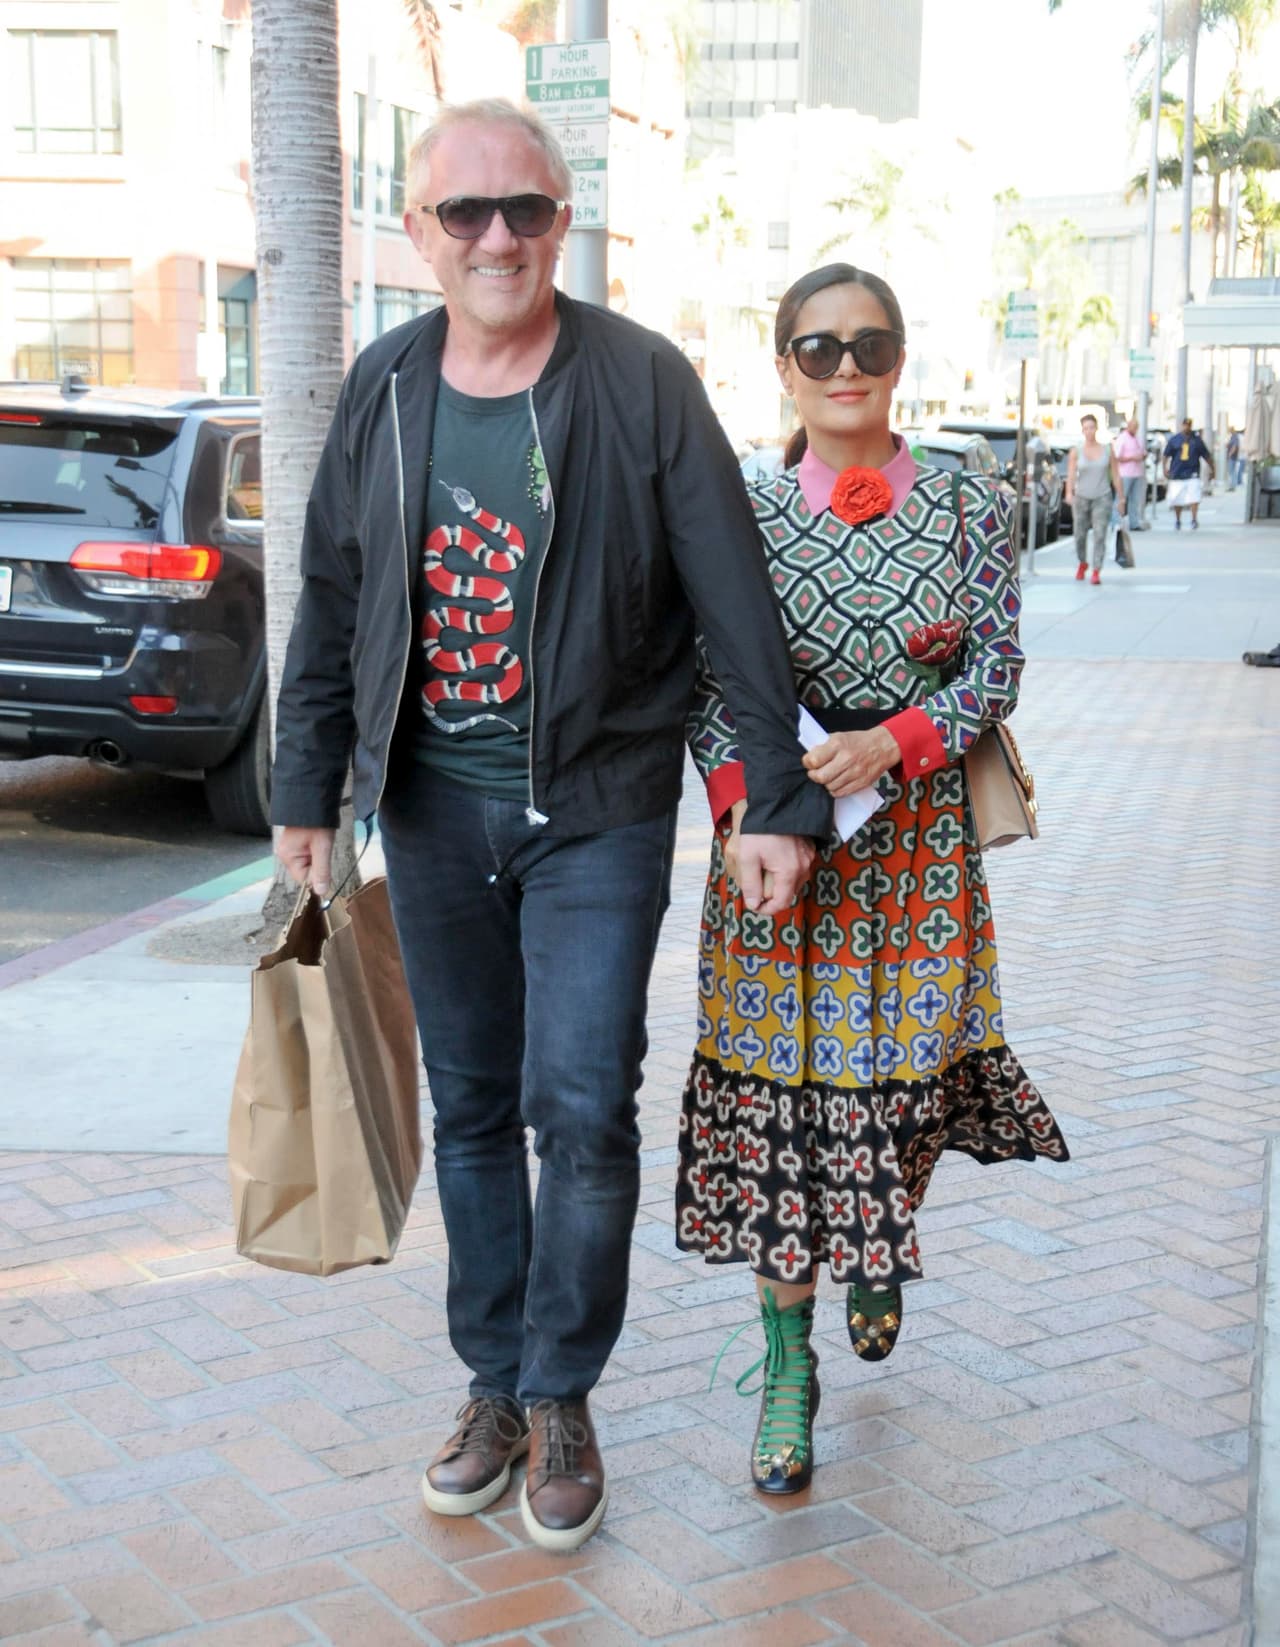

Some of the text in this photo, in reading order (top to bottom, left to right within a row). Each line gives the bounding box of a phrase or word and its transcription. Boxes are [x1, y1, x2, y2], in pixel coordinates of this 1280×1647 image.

[559, 49, 589, 62] HOUR
[532, 50, 538, 78] 1
[551, 65, 598, 80] PARKING
[564, 145, 595, 158] RKING
